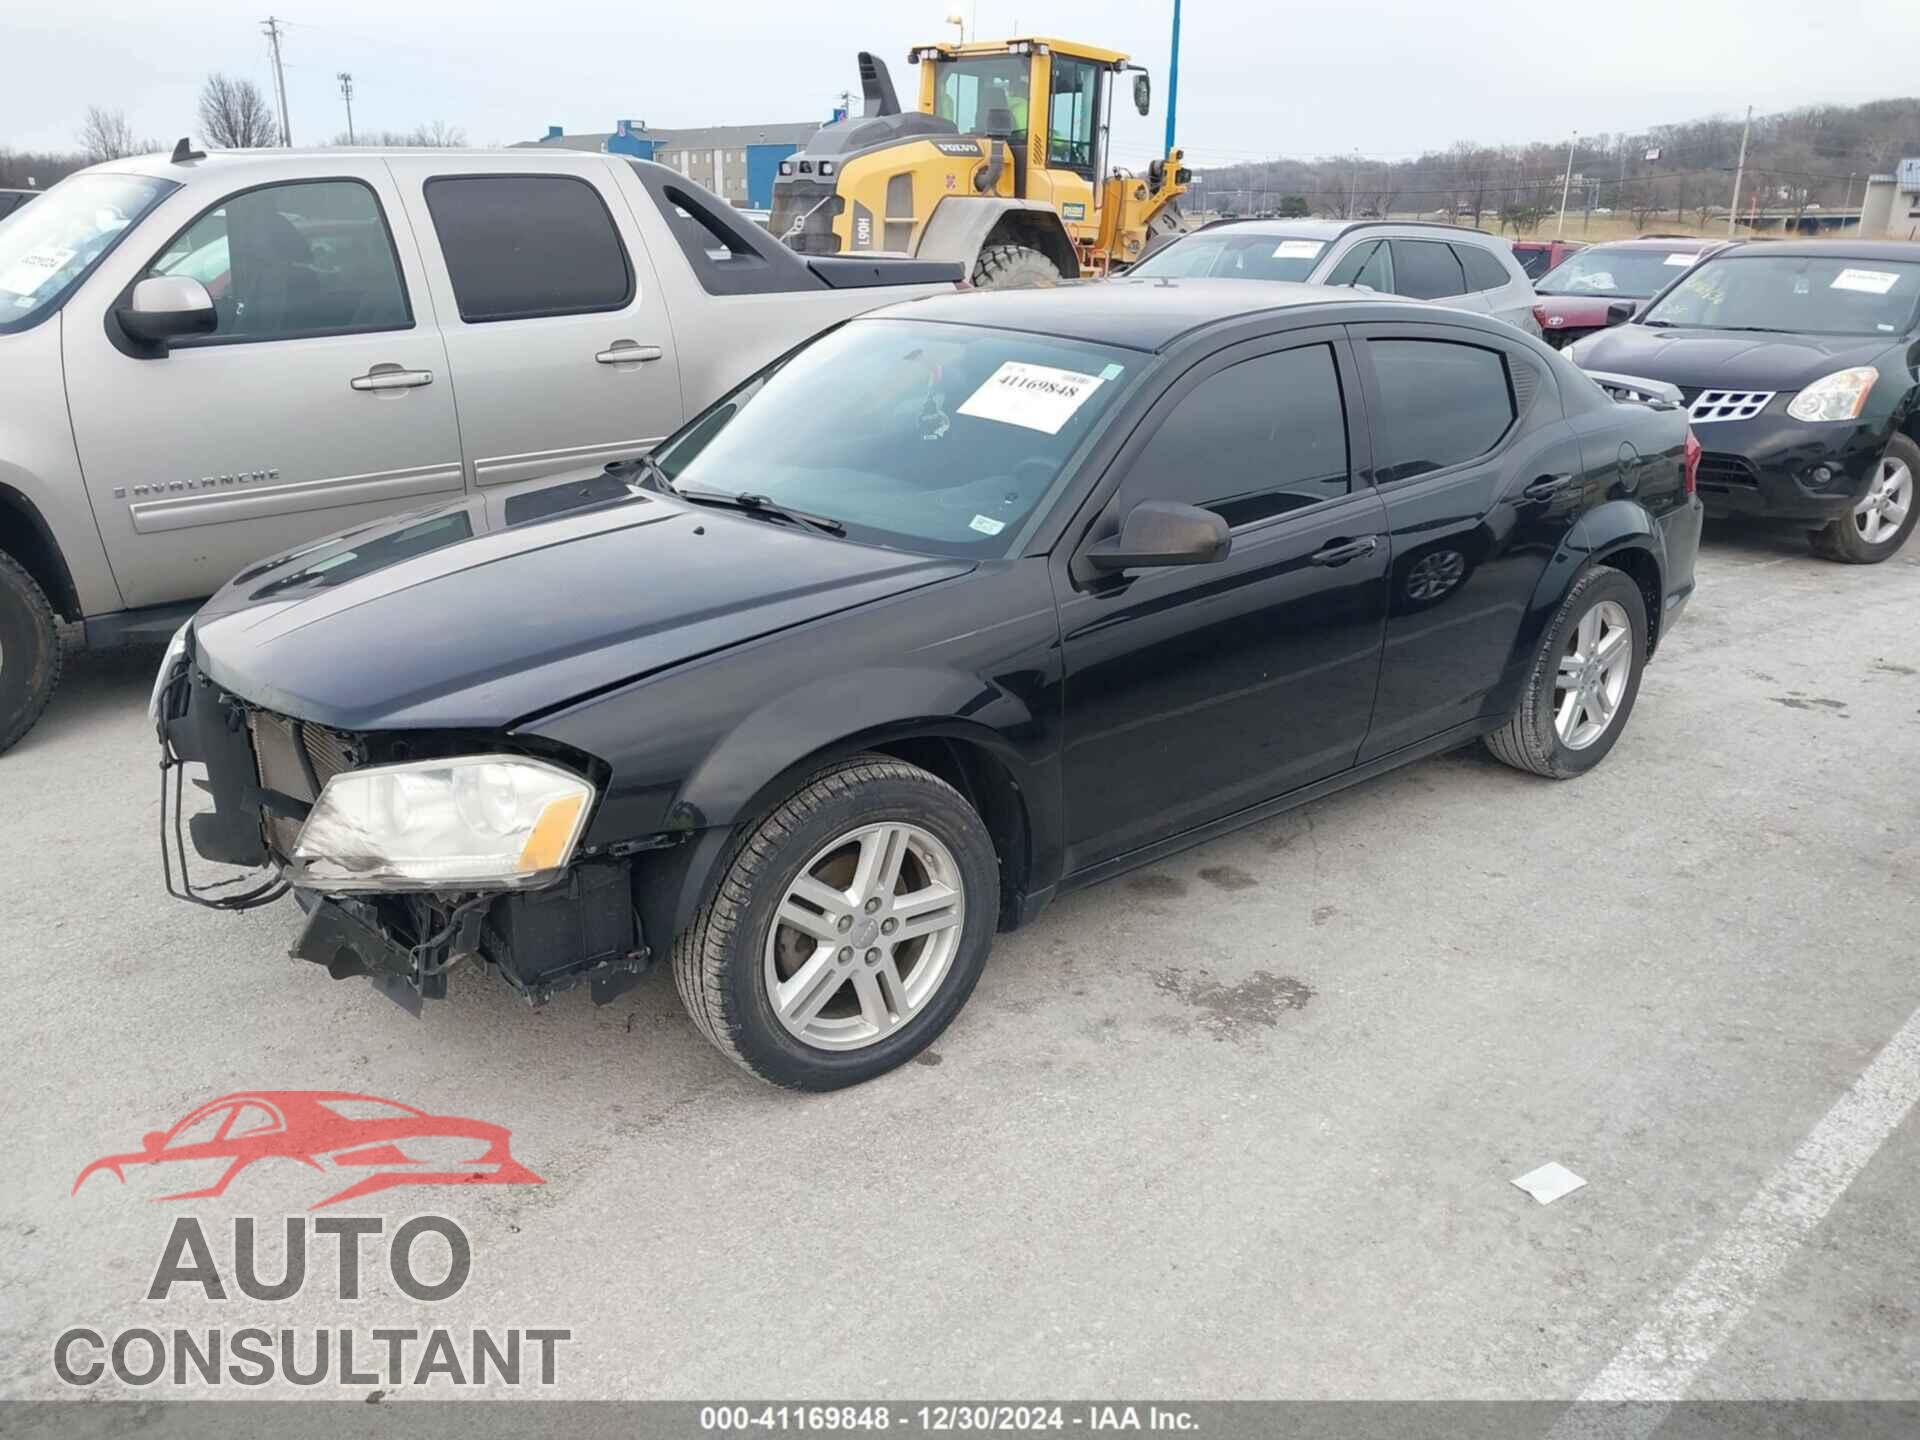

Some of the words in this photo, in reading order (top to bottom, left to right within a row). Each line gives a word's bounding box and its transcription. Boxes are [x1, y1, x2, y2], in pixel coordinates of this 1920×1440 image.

[938, 143, 978, 152] VOLVO
[858, 218, 870, 245] L90H
[999, 375, 1080, 398] 41169848
[133, 468, 280, 496] AVALANCHE
